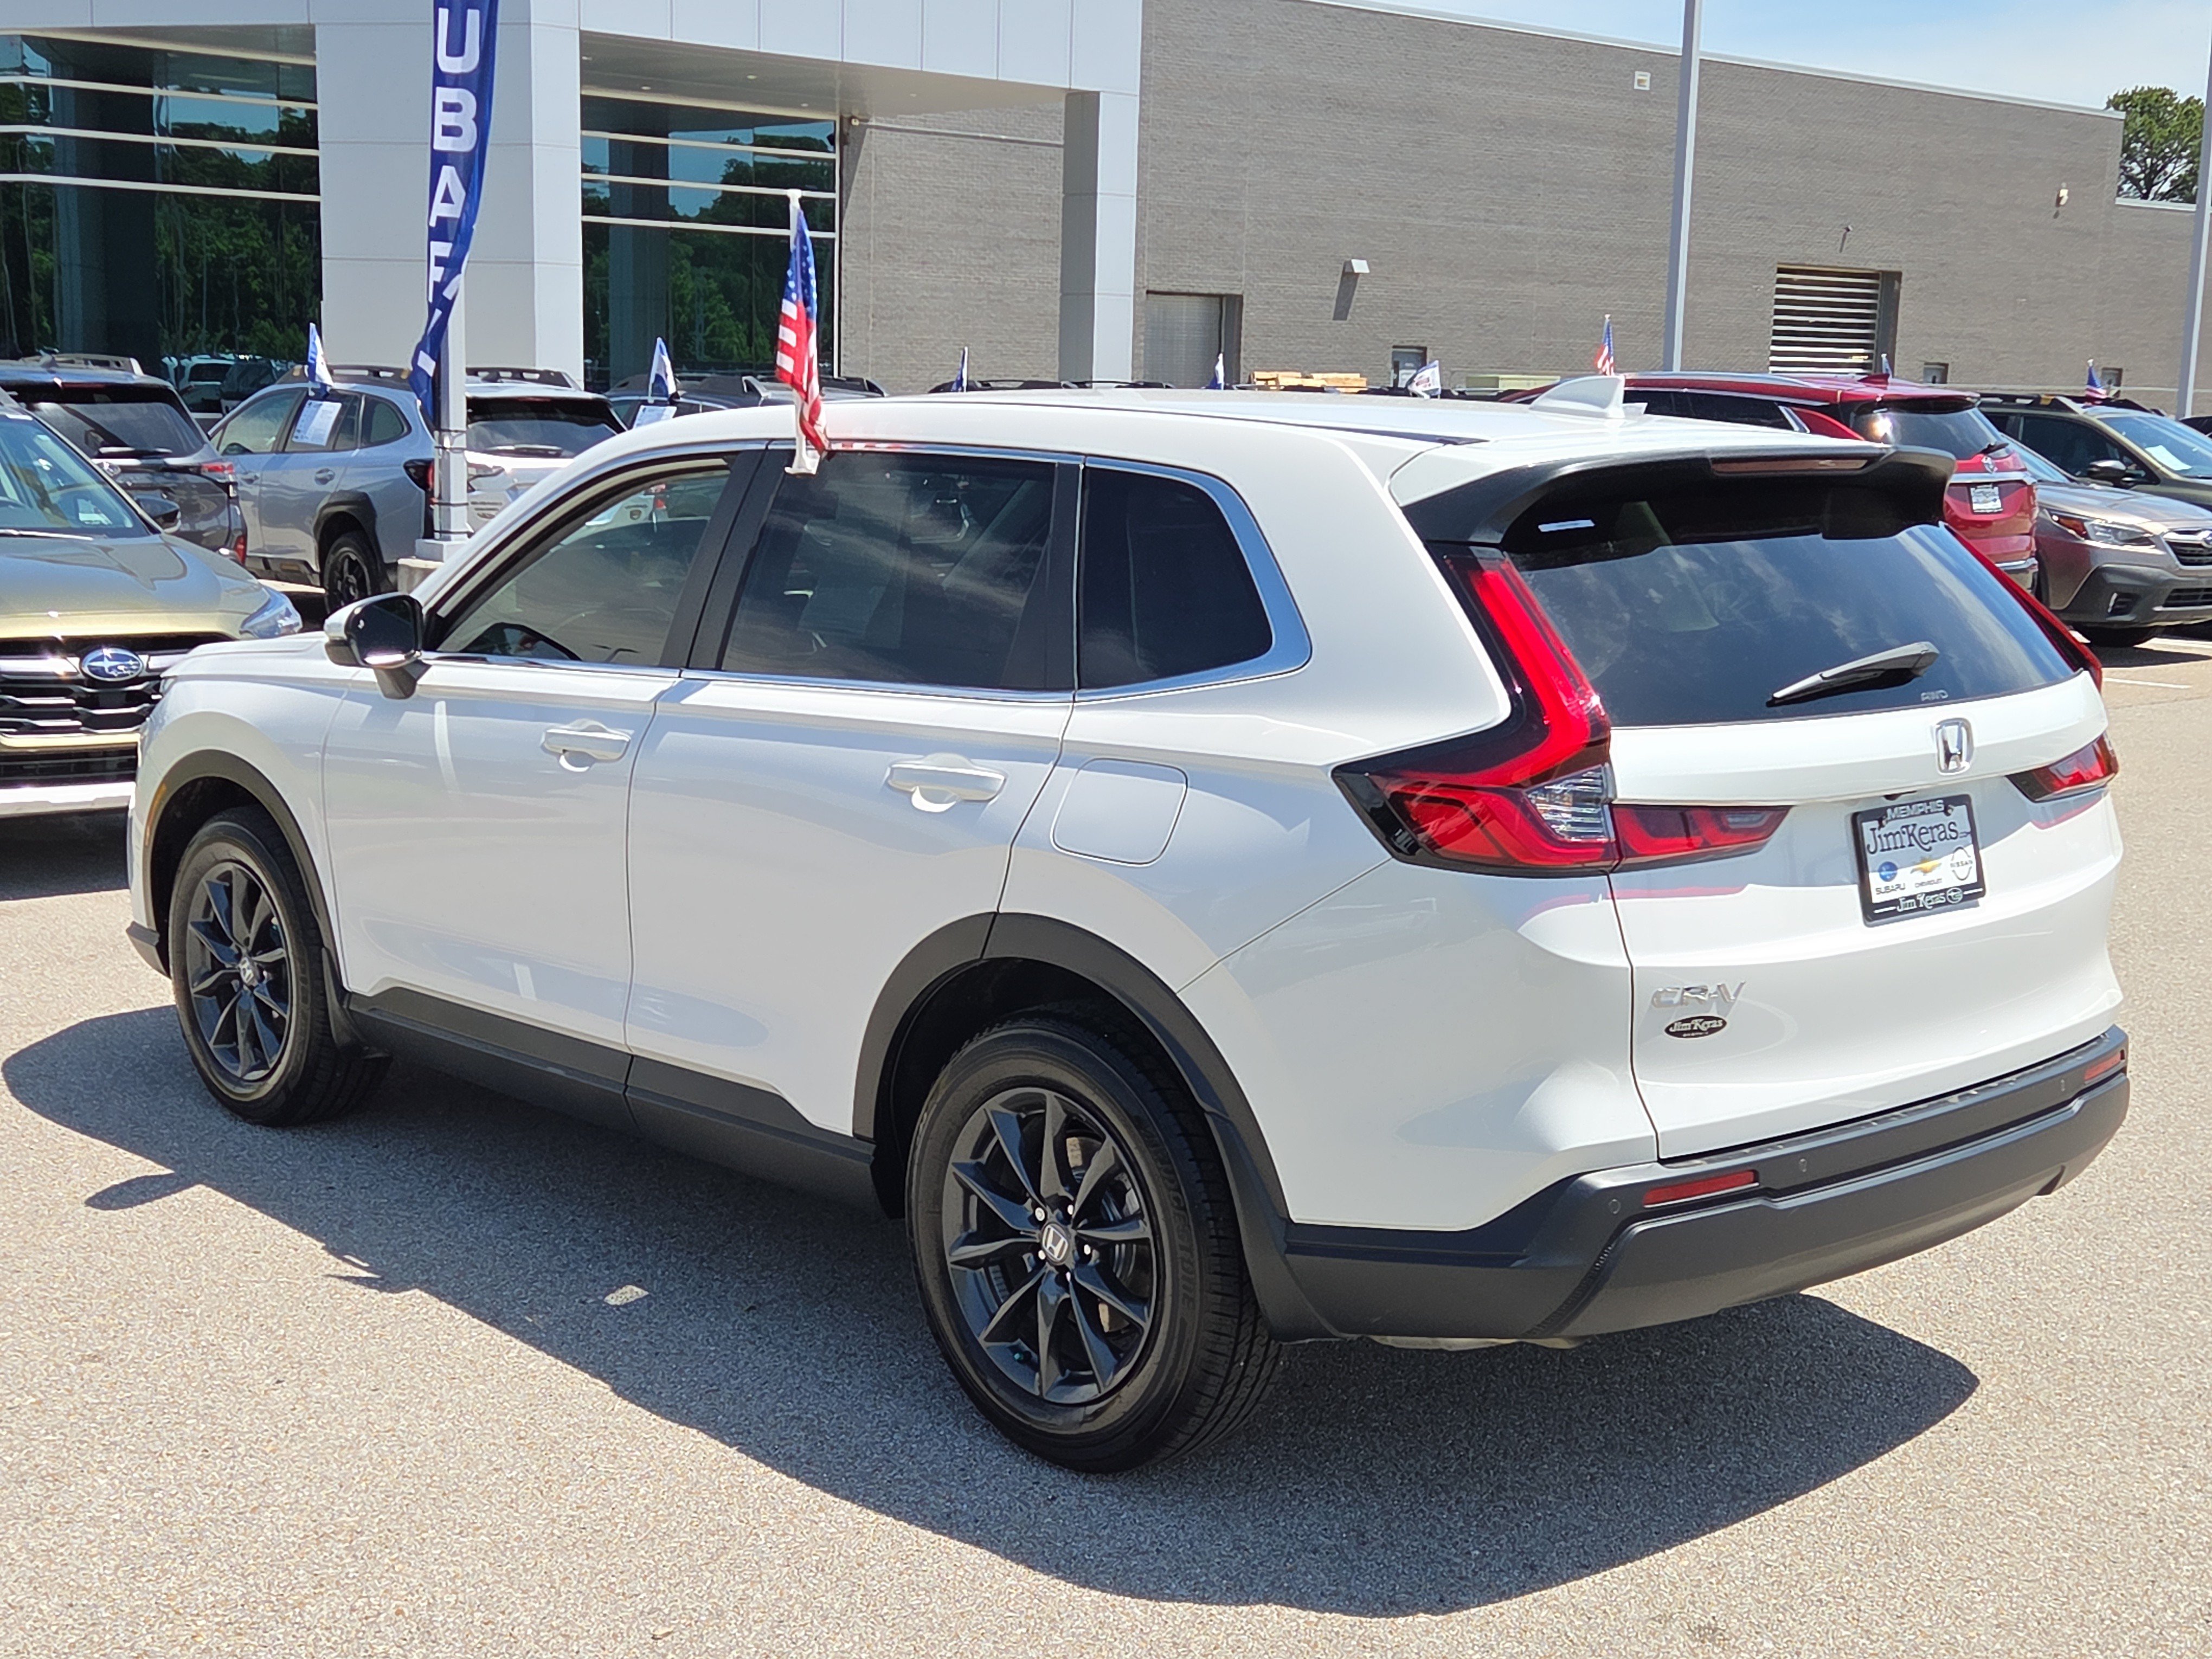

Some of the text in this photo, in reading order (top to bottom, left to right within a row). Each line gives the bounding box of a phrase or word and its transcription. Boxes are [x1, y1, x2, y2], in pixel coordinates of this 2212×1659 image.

[1886, 800, 1944, 819] MEMPHIS
[1875, 883, 1906, 895] SUBARU
[1651, 981, 1746, 1008] CR-V
